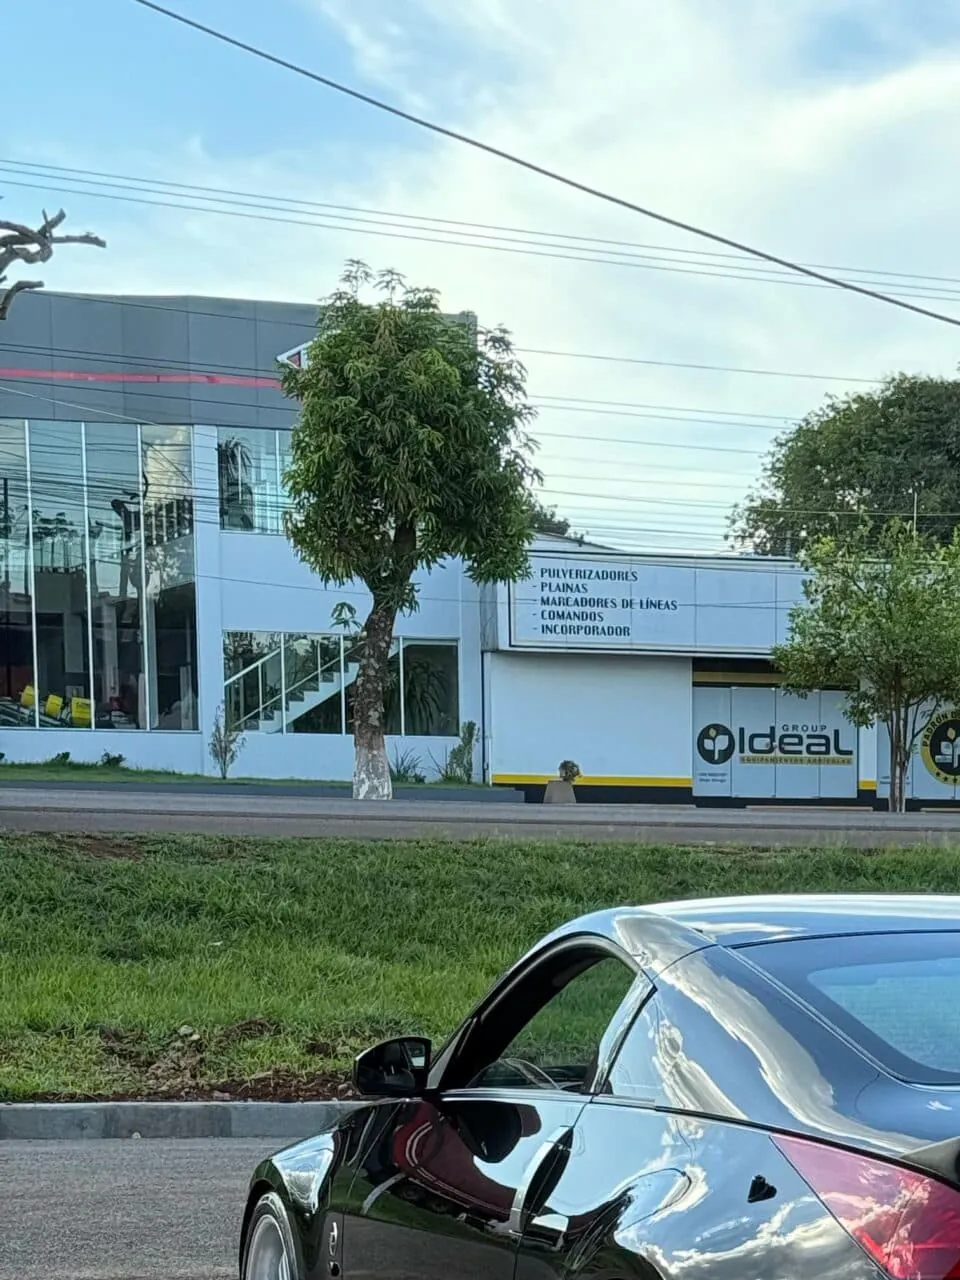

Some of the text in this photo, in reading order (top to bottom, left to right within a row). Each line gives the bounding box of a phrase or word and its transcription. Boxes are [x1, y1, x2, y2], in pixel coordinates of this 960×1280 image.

[540, 567, 638, 581] PULVERIZADORES
[541, 582, 588, 594] PLAINAS
[540, 596, 678, 611] MARCADORES DE LÍNEAS
[541, 610, 604, 622] COMANDOS
[541, 624, 630, 637] INCORPORADOR
[782, 724, 827, 733] GROUP
